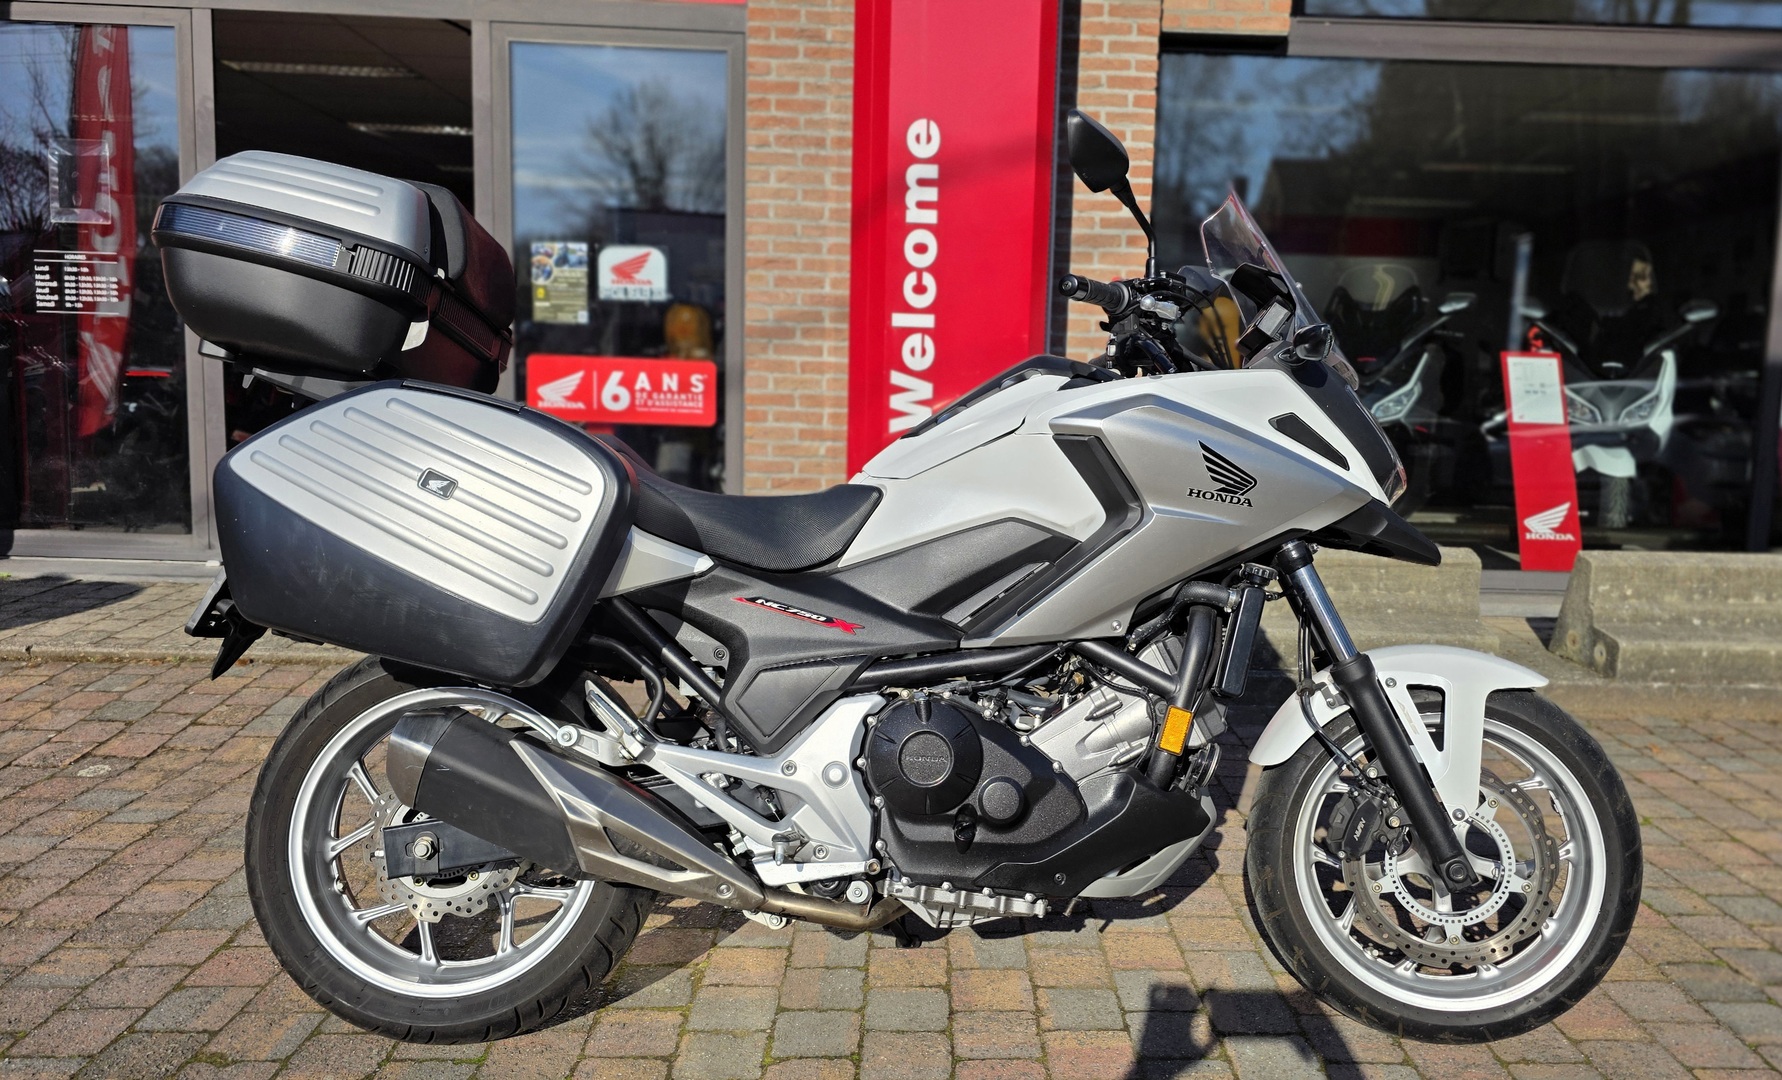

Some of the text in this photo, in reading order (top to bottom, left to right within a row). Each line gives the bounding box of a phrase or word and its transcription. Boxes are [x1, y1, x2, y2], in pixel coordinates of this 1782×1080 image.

[889, 118, 941, 434] Welcome
[601, 370, 631, 412] 6
[635, 391, 704, 401] DE GARANTIE
[635, 398, 704, 409] ET D'ASSISTANCE
[1187, 487, 1254, 508] HONDA
[1525, 531, 1576, 541] HONDA
